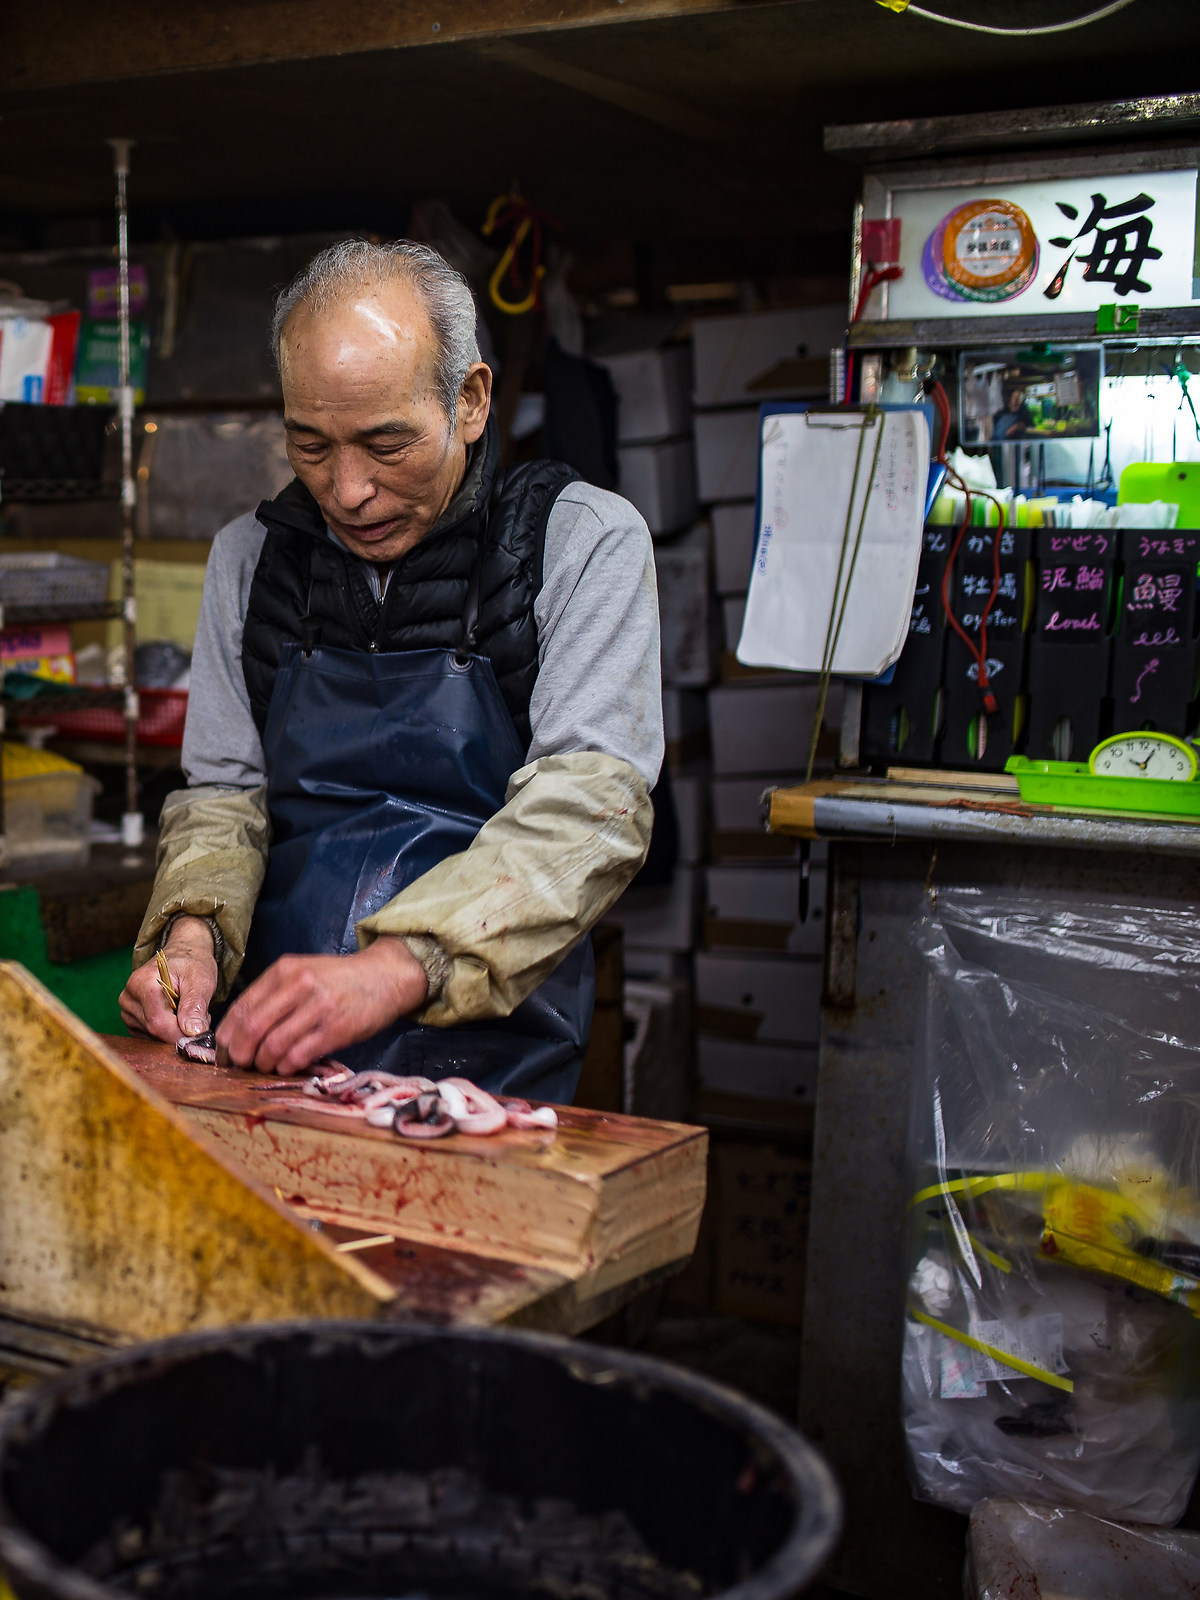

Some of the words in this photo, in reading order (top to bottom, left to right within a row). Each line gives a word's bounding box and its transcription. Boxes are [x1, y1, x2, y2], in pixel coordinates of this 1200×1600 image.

[1043, 192, 1163, 299] 海
[968, 531, 1015, 554] かき
[1051, 535, 1108, 555] どぜう
[1139, 536, 1196, 557] うなぎ
[1133, 627, 1181, 646] eel
[1126, 742, 1134, 751] 11
[1139, 740, 1150, 750] 12
[1156, 743, 1161, 751] 1
[1110, 748, 1124, 758] 10
[1104, 760, 1111, 769] 9
[1177, 762, 1184, 771] 3
